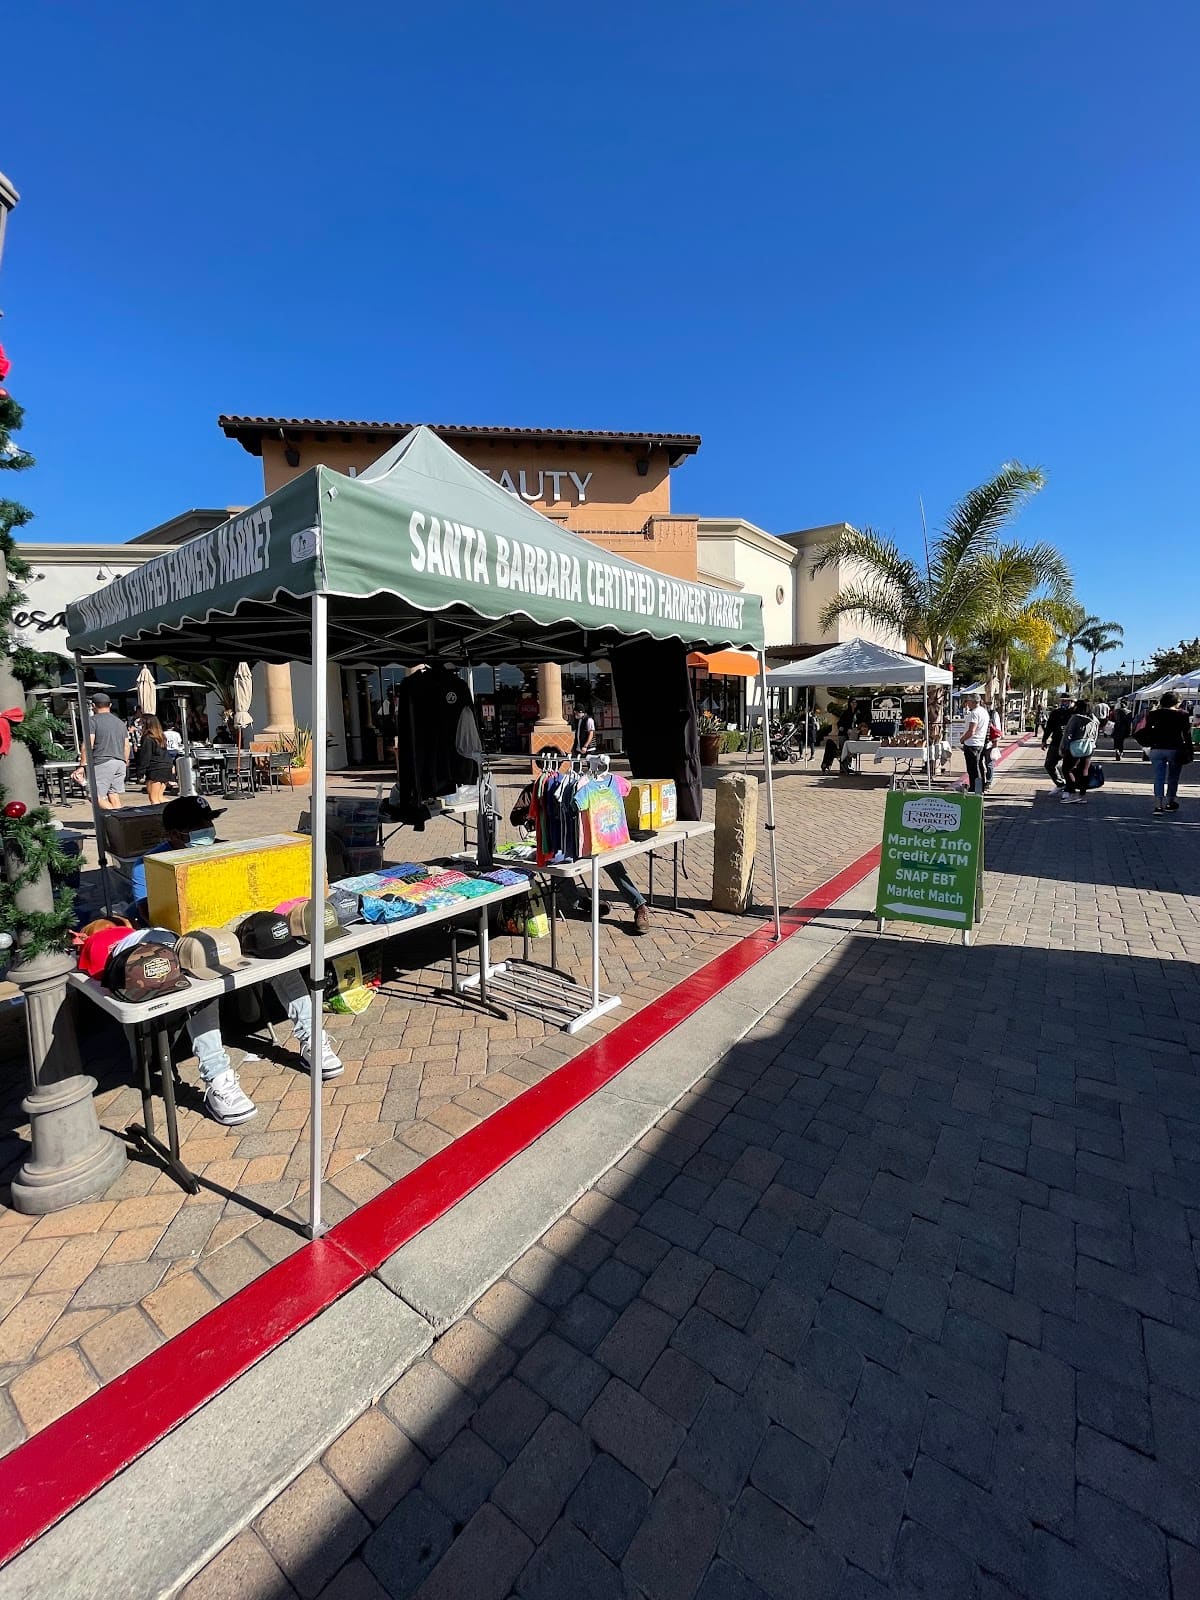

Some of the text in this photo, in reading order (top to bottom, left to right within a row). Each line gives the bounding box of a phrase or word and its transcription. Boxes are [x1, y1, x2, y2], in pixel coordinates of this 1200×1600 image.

[481, 470, 593, 501] AUTY
[126, 560, 168, 617] CERTIFIED
[168, 534, 217, 602] FARMERS
[217, 505, 273, 585] MARKET
[409, 510, 745, 630] SANTA BARBARA CERTIFIED FARMERS MARKET
[871, 710, 902, 720] WOLFE
[888, 833, 972, 852] Market Info
[888, 848, 968, 867] Credit/ATM
[895, 868, 957, 887] SNAP EBT
[886, 883, 963, 905] Market Match
